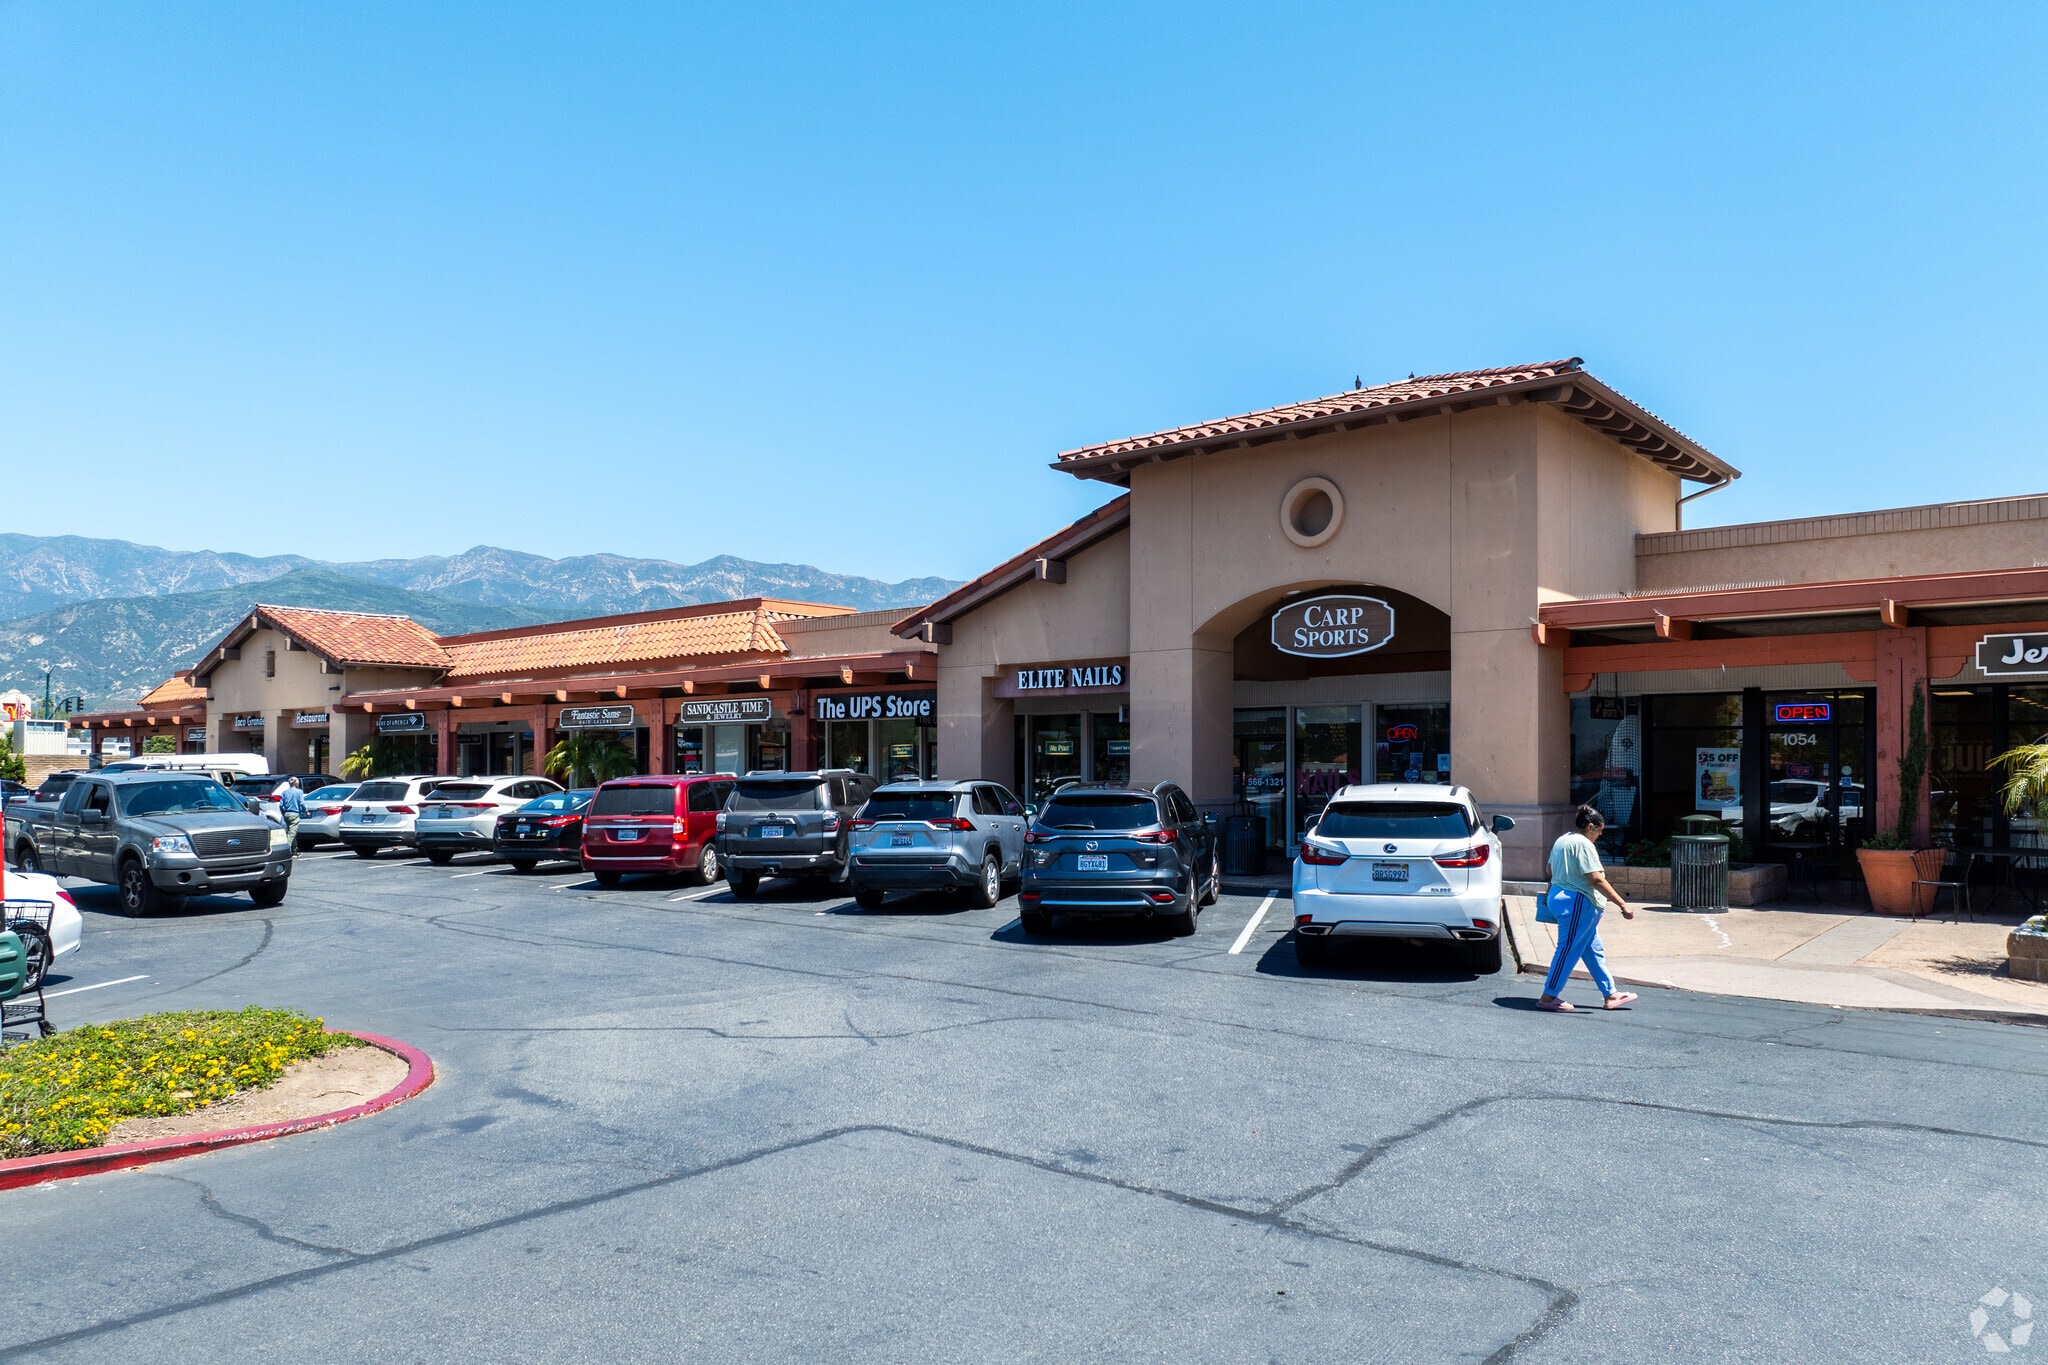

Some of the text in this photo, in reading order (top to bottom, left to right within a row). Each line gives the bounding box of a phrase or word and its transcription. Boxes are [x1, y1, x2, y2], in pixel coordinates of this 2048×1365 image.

[1304, 606, 1363, 627] CARP
[1294, 628, 1369, 648] SPORTS
[1018, 666, 1121, 689] ELITE NAILS
[687, 701, 763, 715] SANDCASTLE TIME
[818, 695, 930, 718] The UPS Store
[1779, 706, 1827, 719] OPEN
[296, 713, 327, 724] Restaurant
[571, 709, 621, 720] Fantastic Sams
[235, 716, 246, 727] Taco
[1386, 727, 1418, 739] OPEN
[1781, 734, 1817, 745] 1054
[1698, 753, 1715, 762] $25
[1718, 753, 1739, 762] OFF
[1247, 778, 1284, 786] 566-1321
